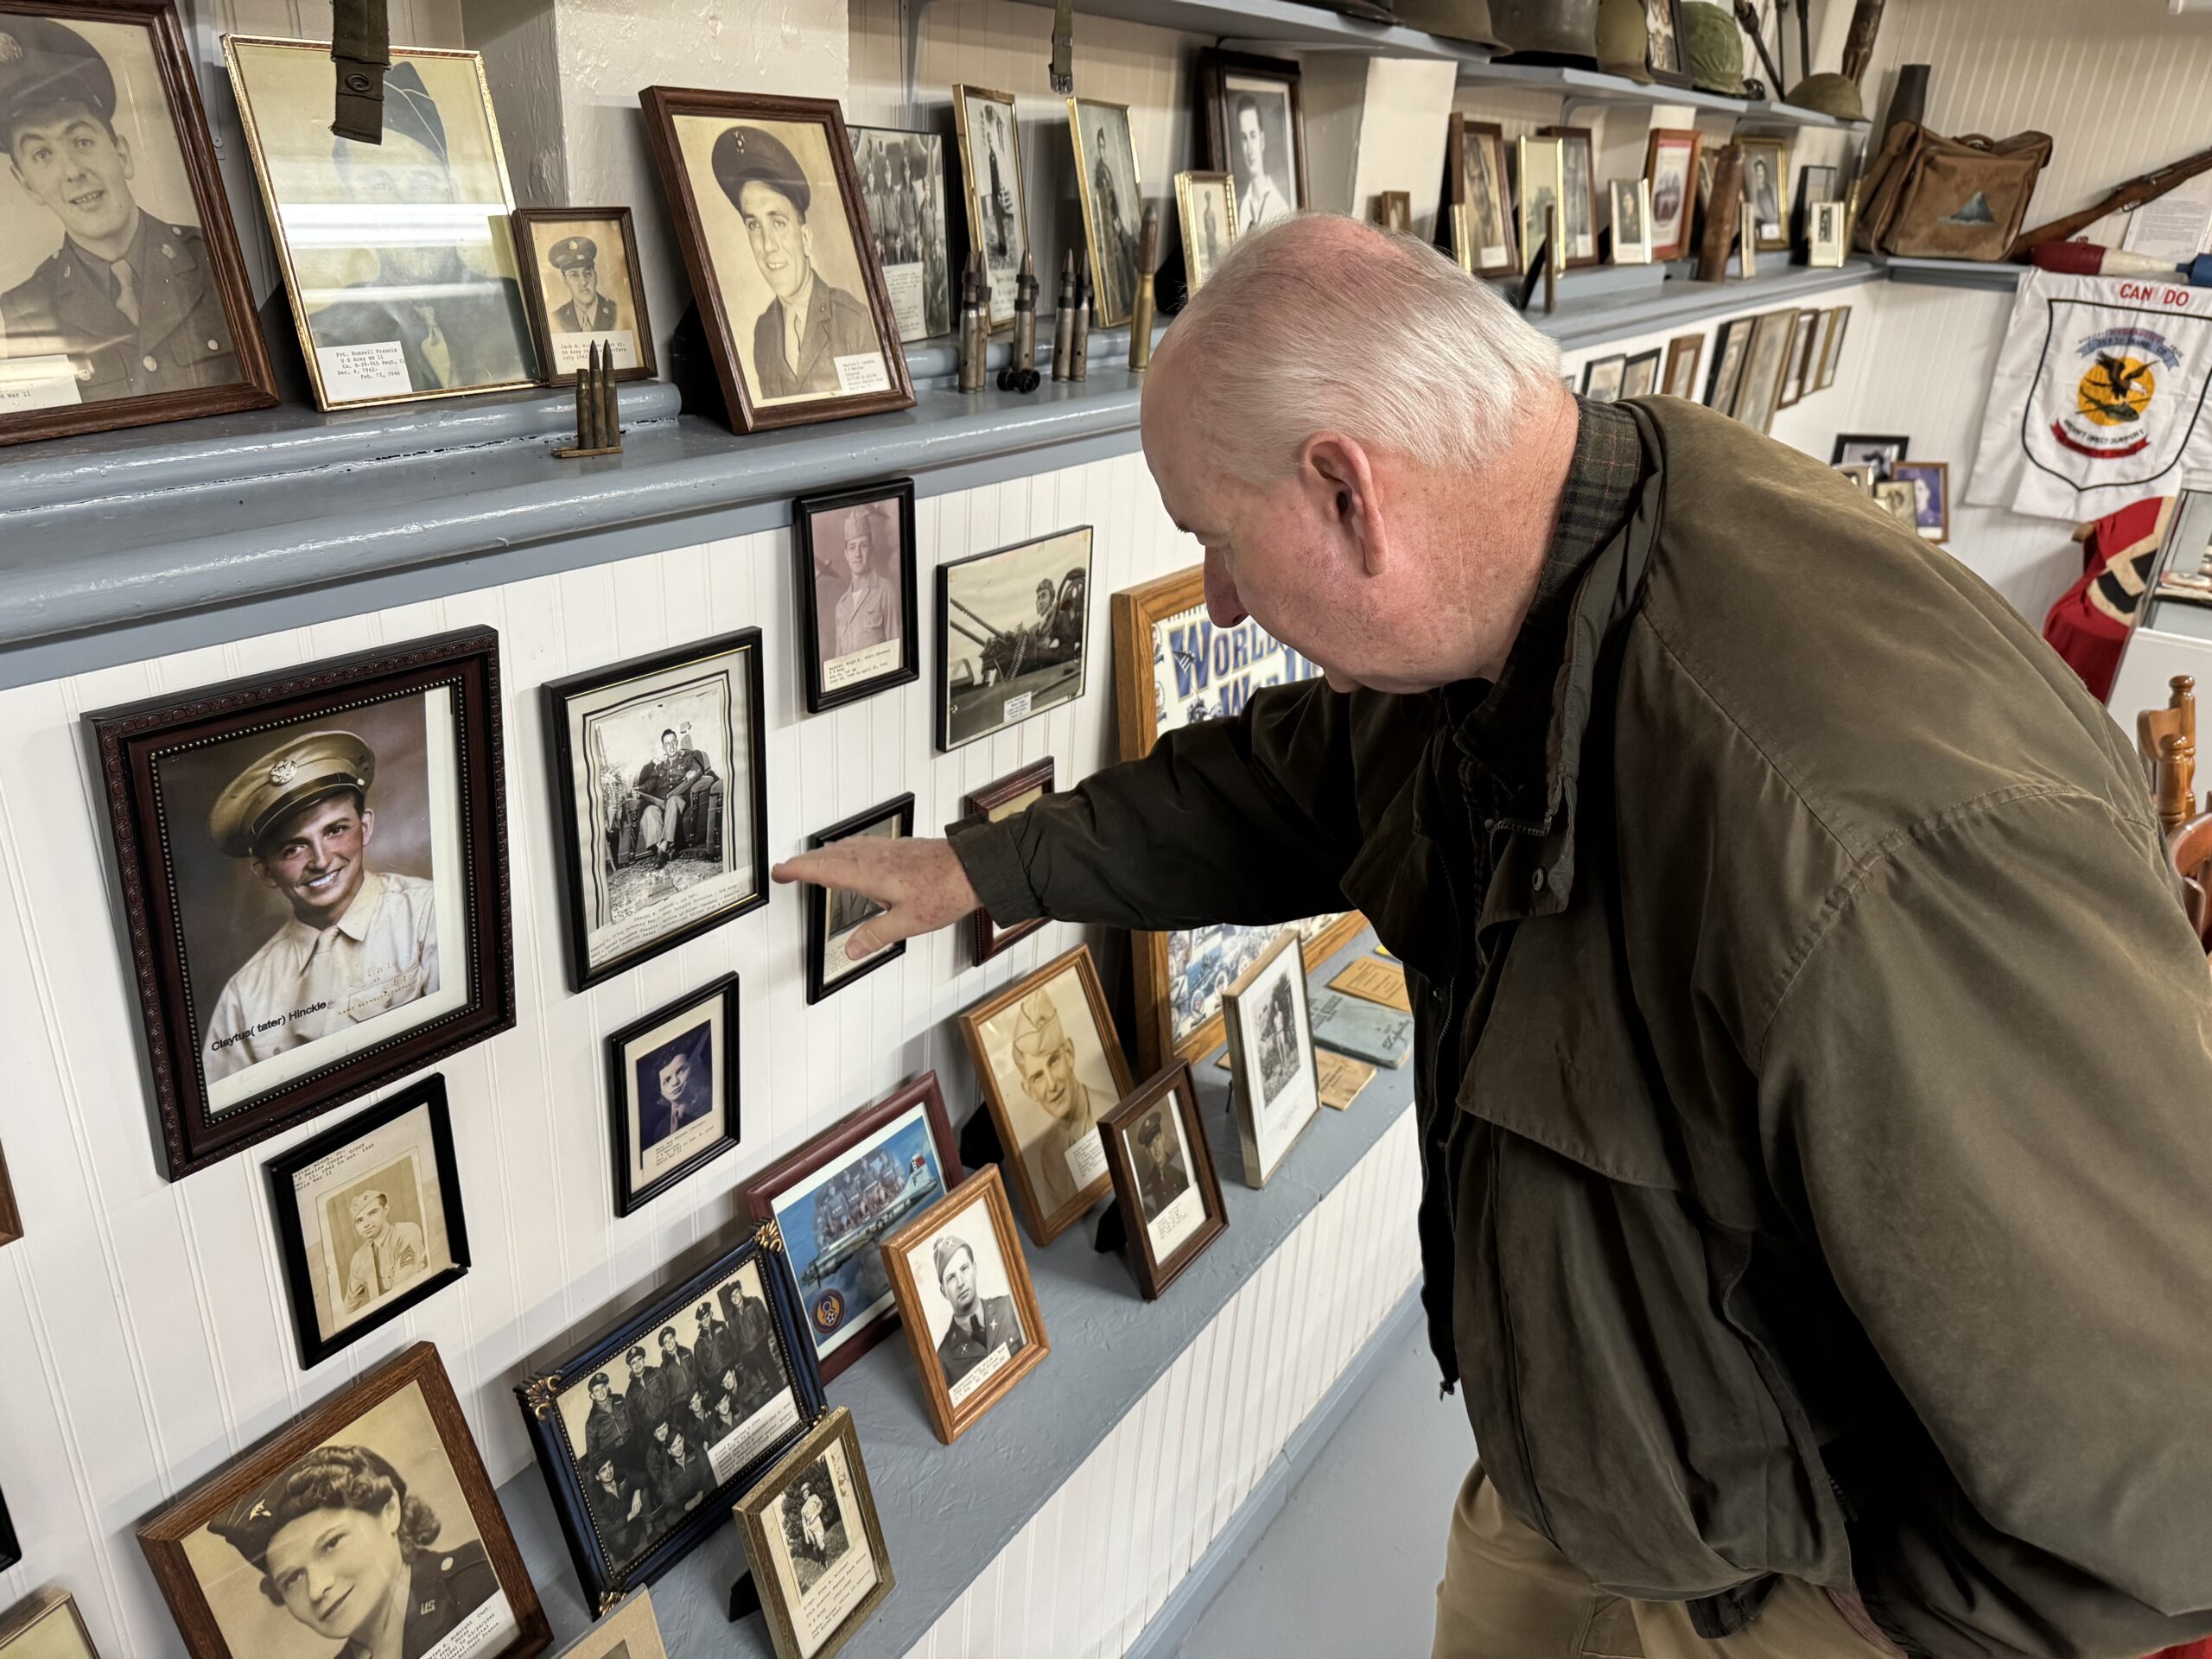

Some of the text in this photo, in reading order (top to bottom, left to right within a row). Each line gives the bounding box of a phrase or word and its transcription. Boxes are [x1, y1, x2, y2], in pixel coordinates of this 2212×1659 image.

[2120, 283, 2189, 306] CAN DO
[257, 1014, 286, 1033] tater)
[289, 1001, 327, 1020] Hinckle
[294, 1166, 310, 1178] alter
[304, 1165, 325, 1176] Marine
[296, 1182, 310, 1192] orld
[421, 1599, 435, 1615] US
[477, 1605, 491, 1618] Capt.
[467, 1624, 490, 1644] Hospital
